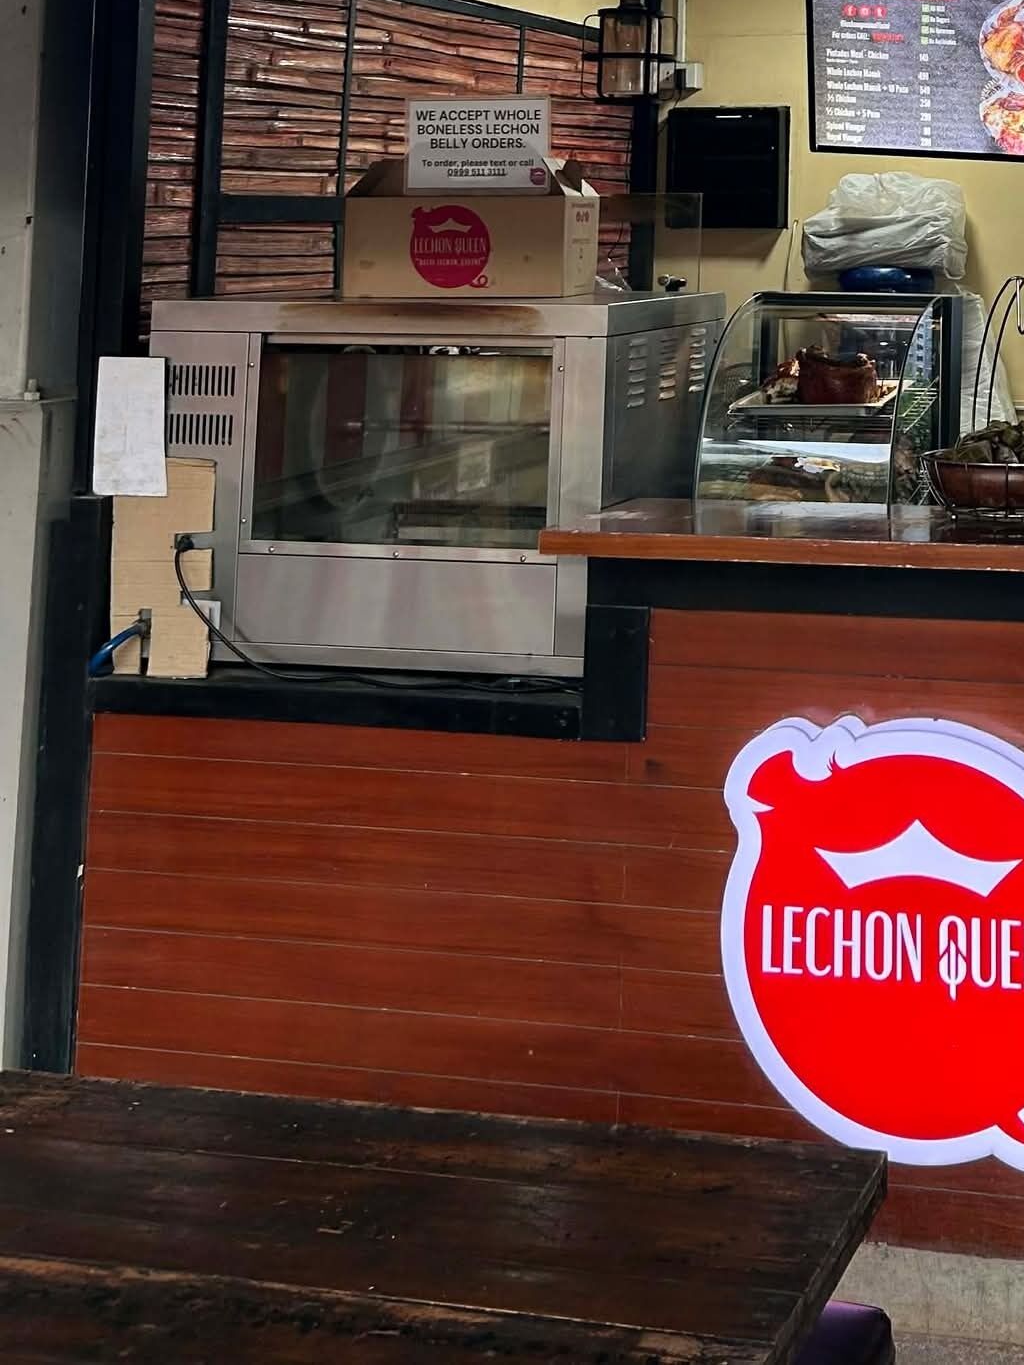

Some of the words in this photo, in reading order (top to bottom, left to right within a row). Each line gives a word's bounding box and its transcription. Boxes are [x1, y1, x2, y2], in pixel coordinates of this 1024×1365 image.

[416, 110, 437, 121] WE
[439, 110, 490, 121] ACCEPT
[494, 109, 542, 121] WHOLE
[417, 124, 483, 135] BONELESS
[486, 124, 540, 135] LECHON
[430, 138, 468, 149] BELLY
[471, 137, 526, 149] ORDERS.
[422, 159, 432, 167] To
[434, 159, 460, 168] order,
[461, 159, 493, 169] please
[495, 159, 507, 167] text
[414, 236, 451, 254] LECHON
[762, 904, 922, 984] LECHON
